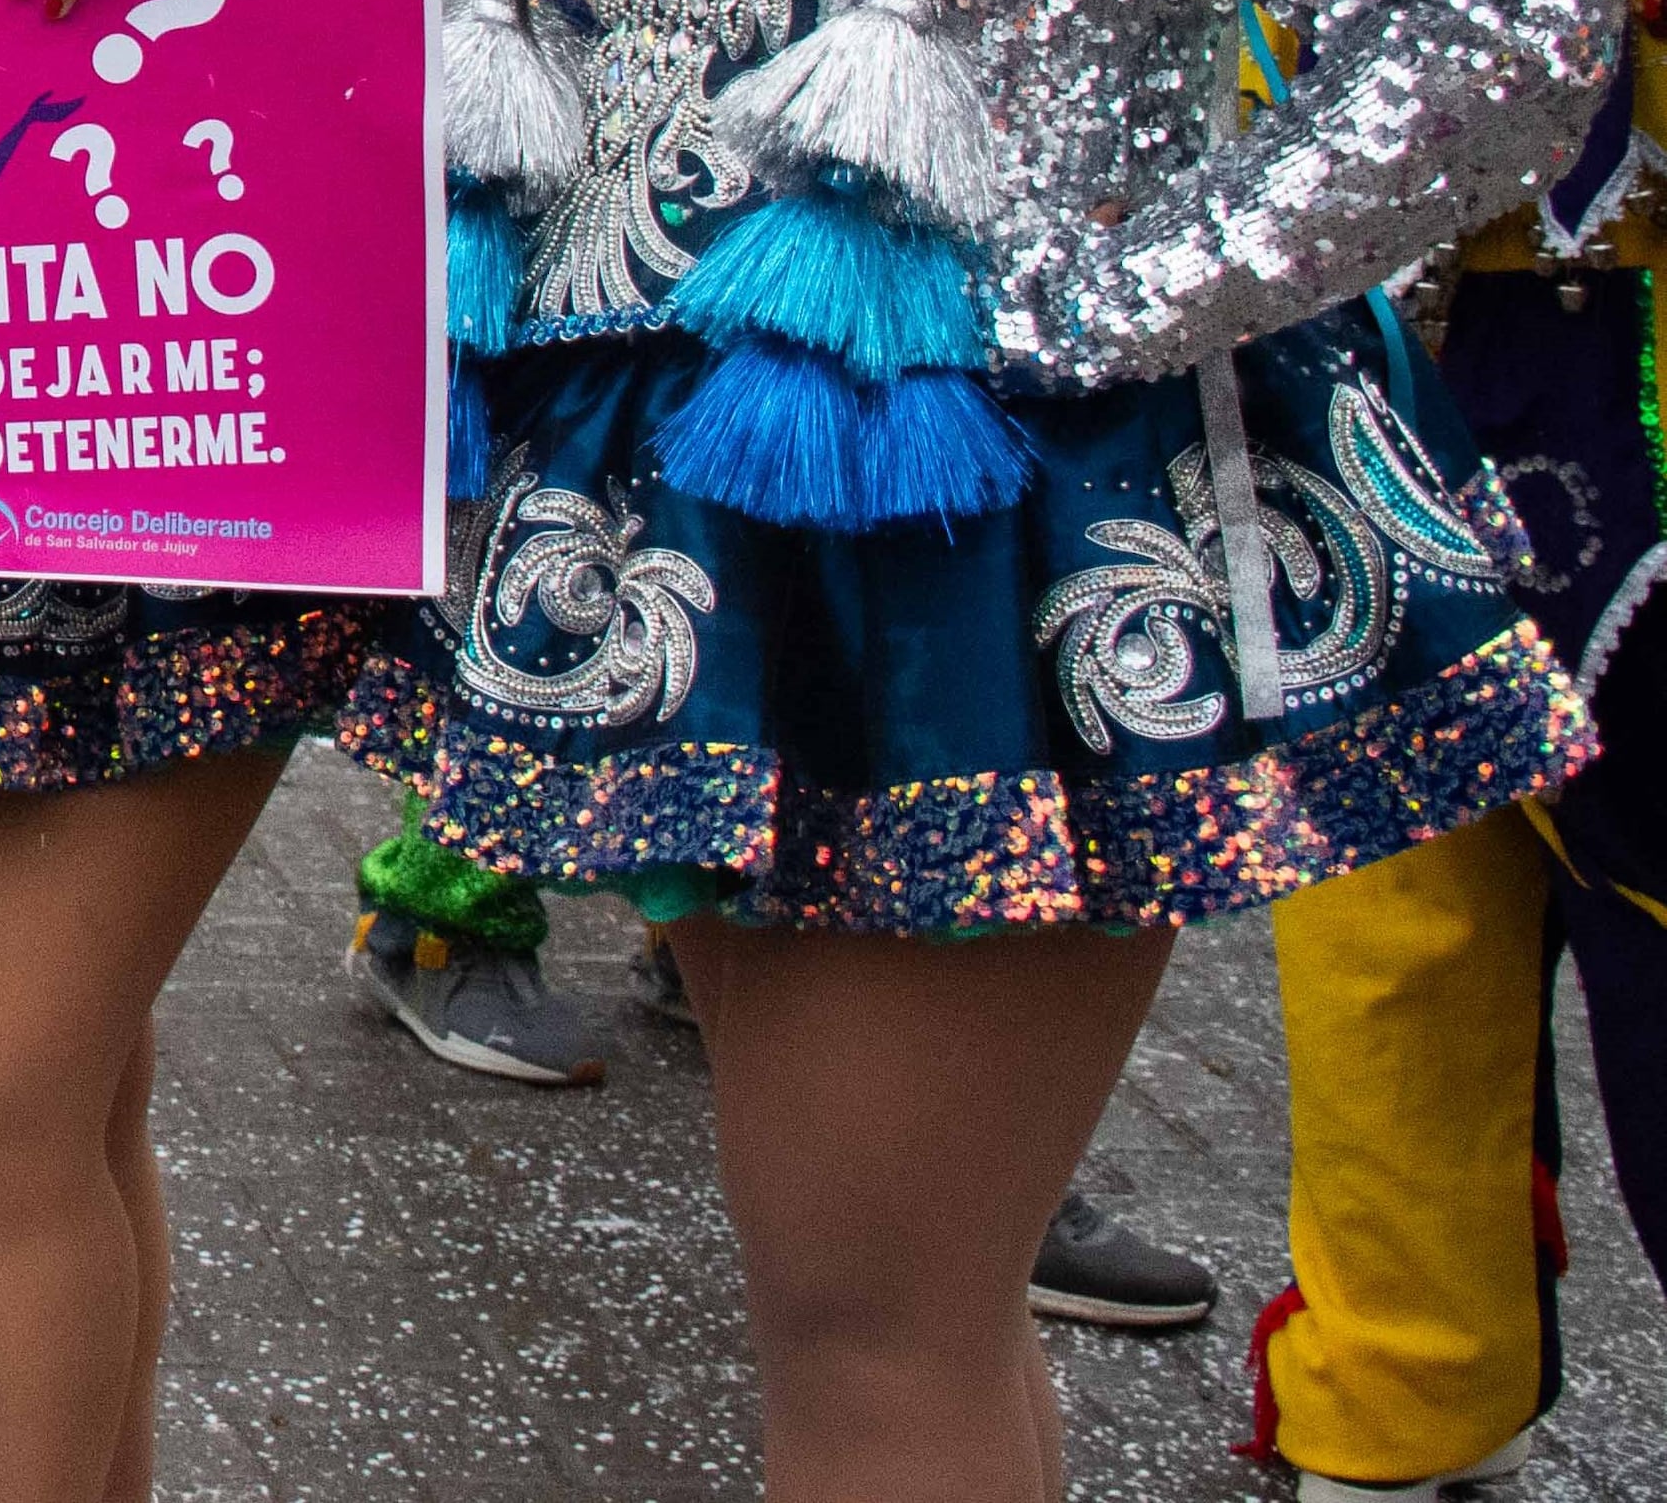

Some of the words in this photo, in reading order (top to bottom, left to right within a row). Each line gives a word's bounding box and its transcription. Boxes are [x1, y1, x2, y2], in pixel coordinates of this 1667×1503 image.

[135, 234, 274, 316] NO
[25, 506, 123, 536] Concejo
[132, 510, 272, 539] Deliberante
[25, 534, 41, 546] de
[46, 534, 71, 548] San
[76, 535, 139, 551] Salvador
[142, 539, 158, 552] de
[162, 540, 198, 556] Jujuy
